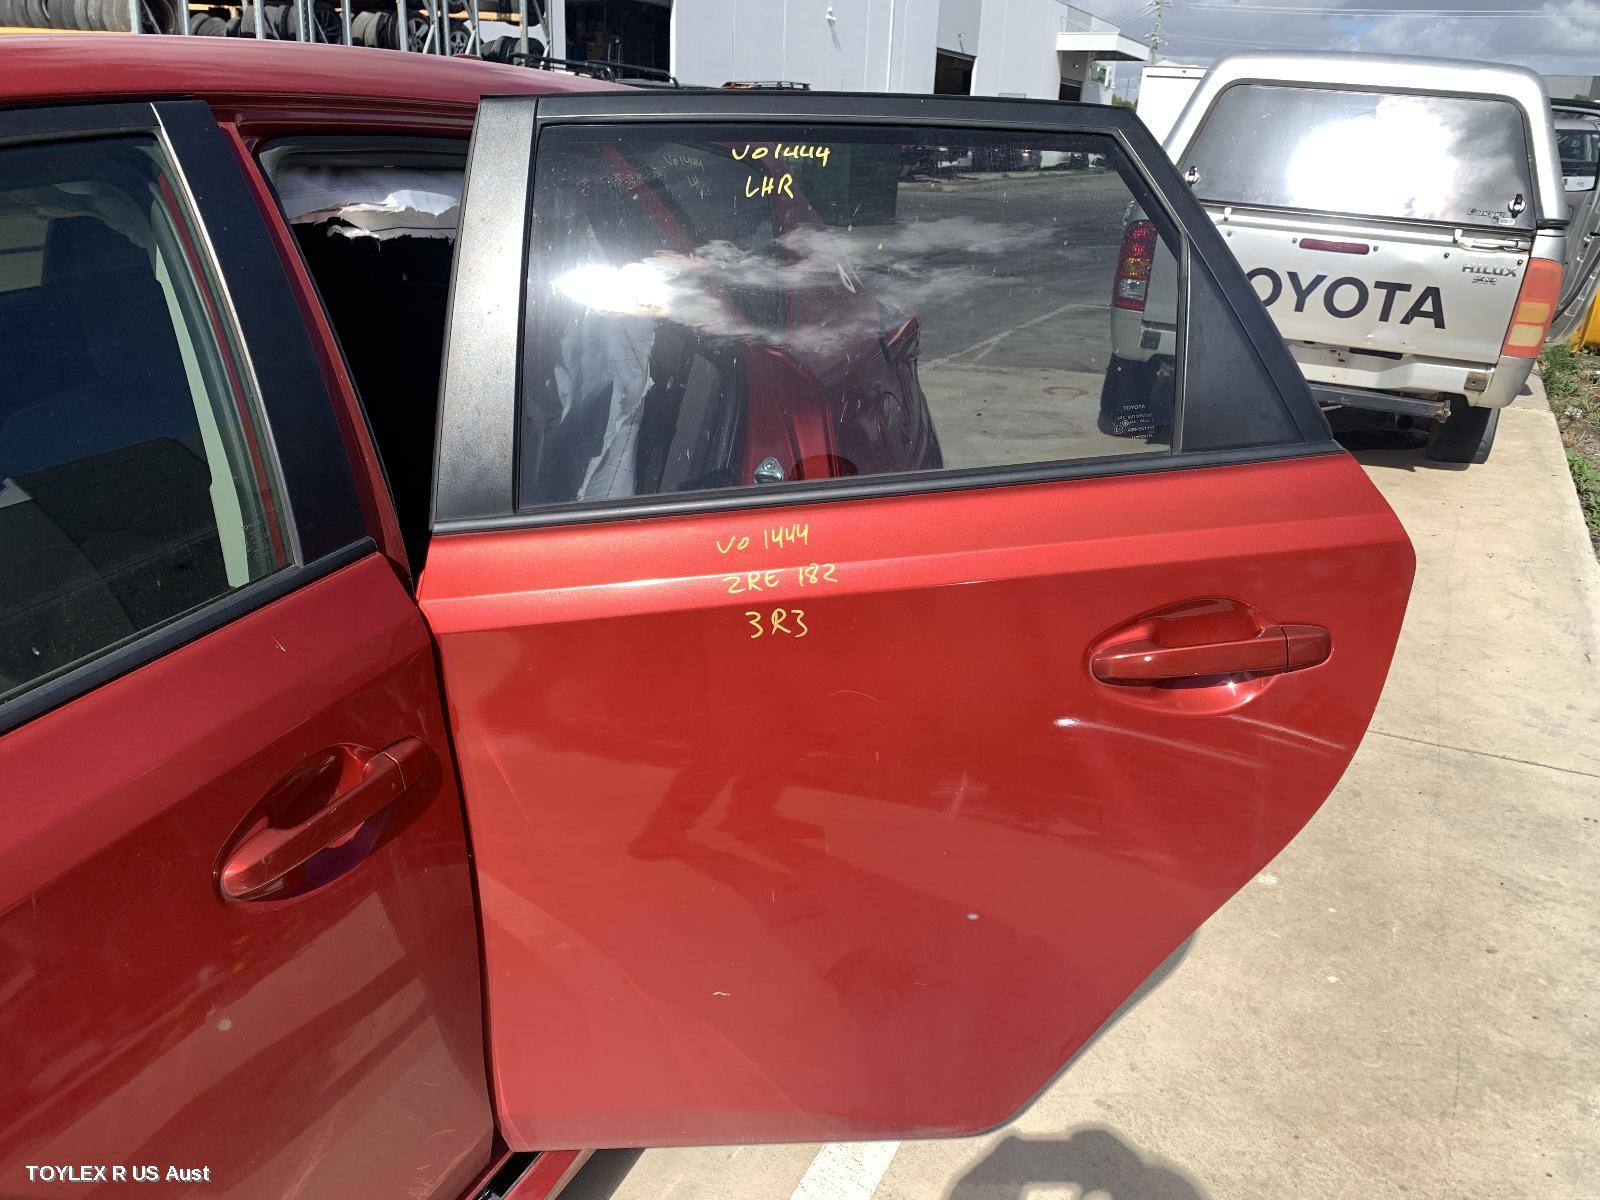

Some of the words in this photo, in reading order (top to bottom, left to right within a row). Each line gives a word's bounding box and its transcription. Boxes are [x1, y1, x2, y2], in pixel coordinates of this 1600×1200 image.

[744, 174, 795, 200] LHR
[1461, 263, 1518, 278] HILUX
[1245, 266, 1447, 330] OYOTA
[763, 523, 809, 550] 1444
[798, 562, 838, 587] 182
[744, 607, 809, 639] 3R3
